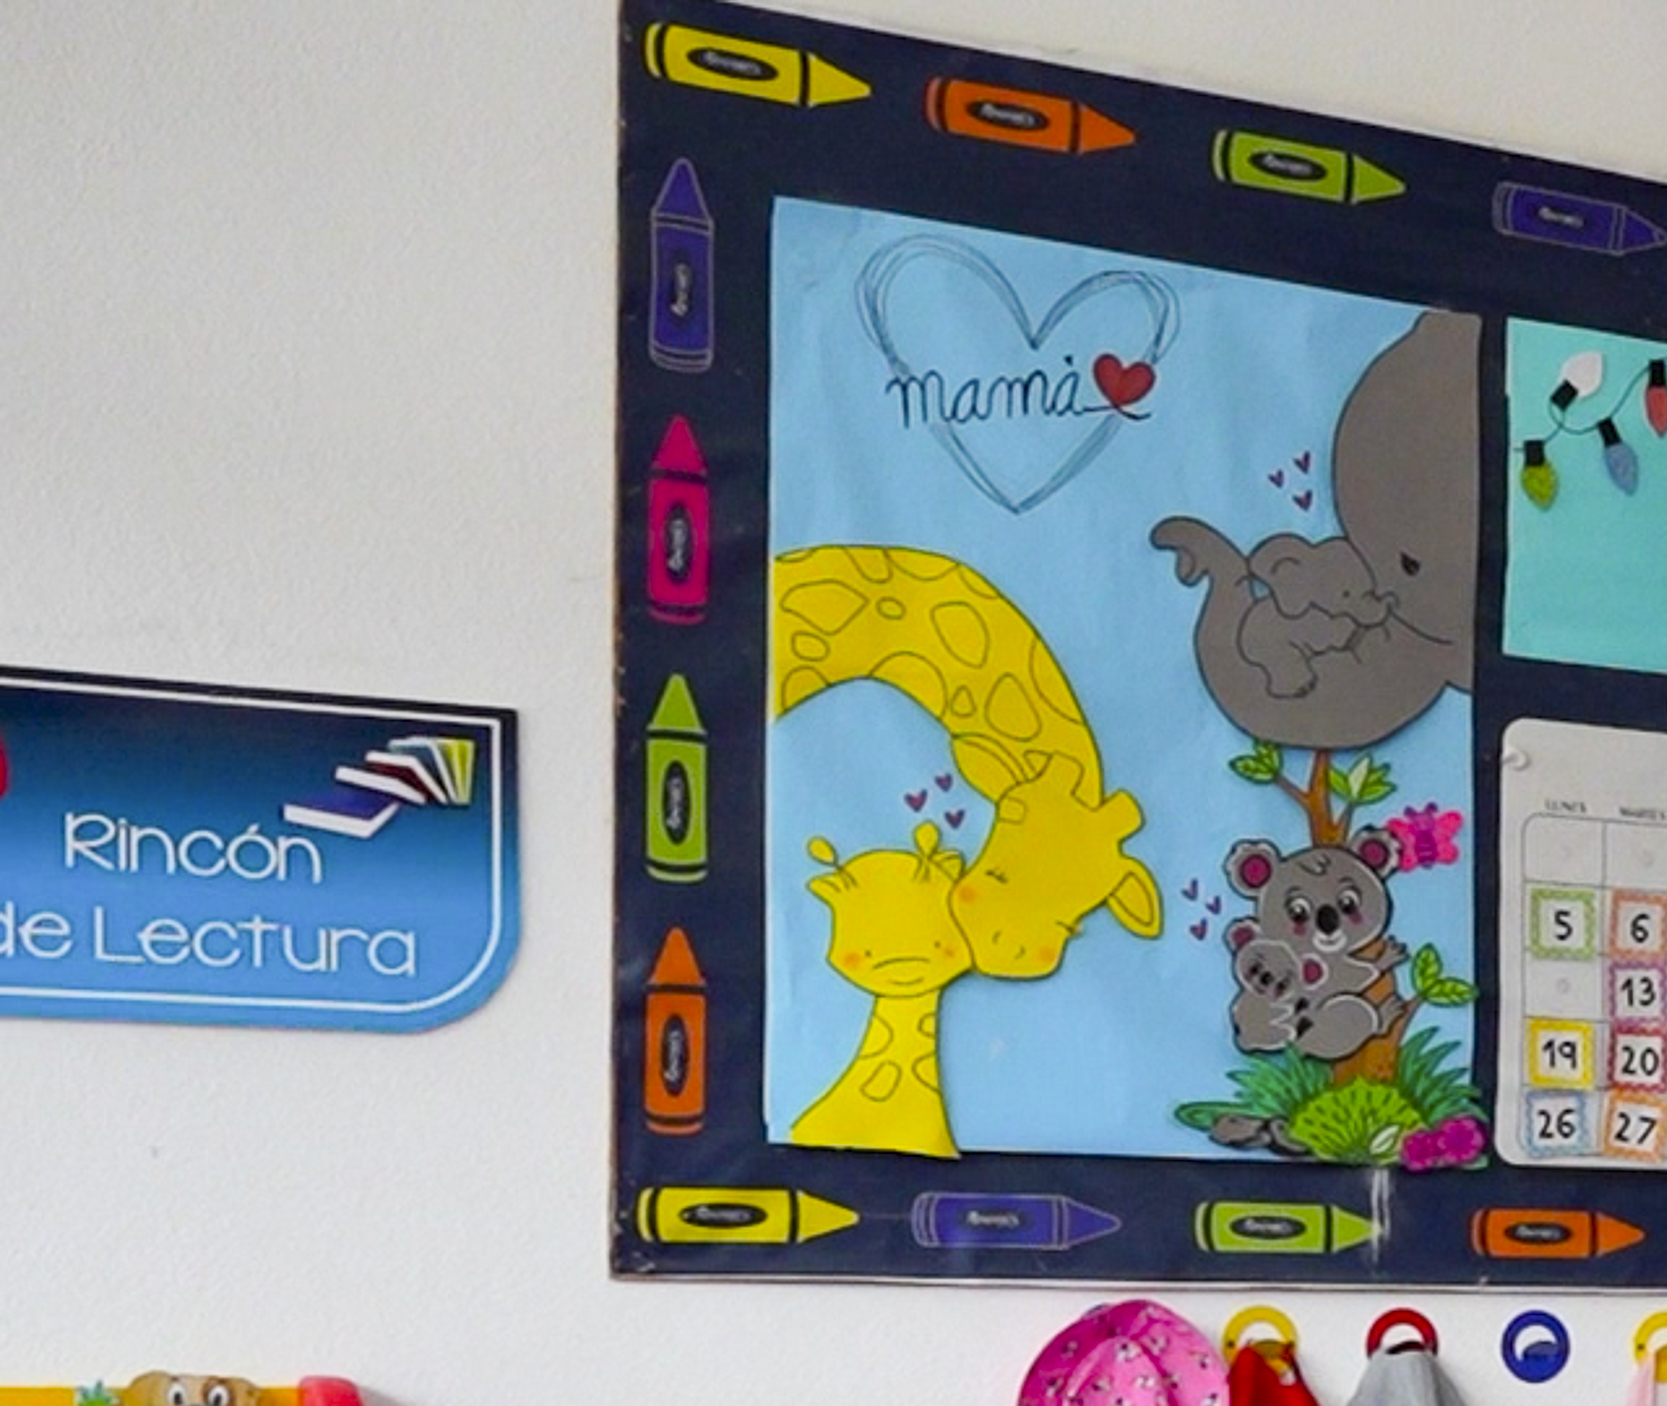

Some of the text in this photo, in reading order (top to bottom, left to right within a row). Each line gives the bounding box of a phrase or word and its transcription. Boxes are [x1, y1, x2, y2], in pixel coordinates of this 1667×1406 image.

[64, 812, 323, 884] Rincón
[93, 905, 417, 978] Lectura
[1554, 909, 1573, 941] 5
[1630, 913, 1650, 944] 6
[1620, 976, 1656, 1007] 13
[1542, 1039, 1577, 1069] 19
[1621, 1045, 1660, 1077] 20
[1537, 1108, 1576, 1139] 26
[1614, 1111, 1658, 1145] 27
